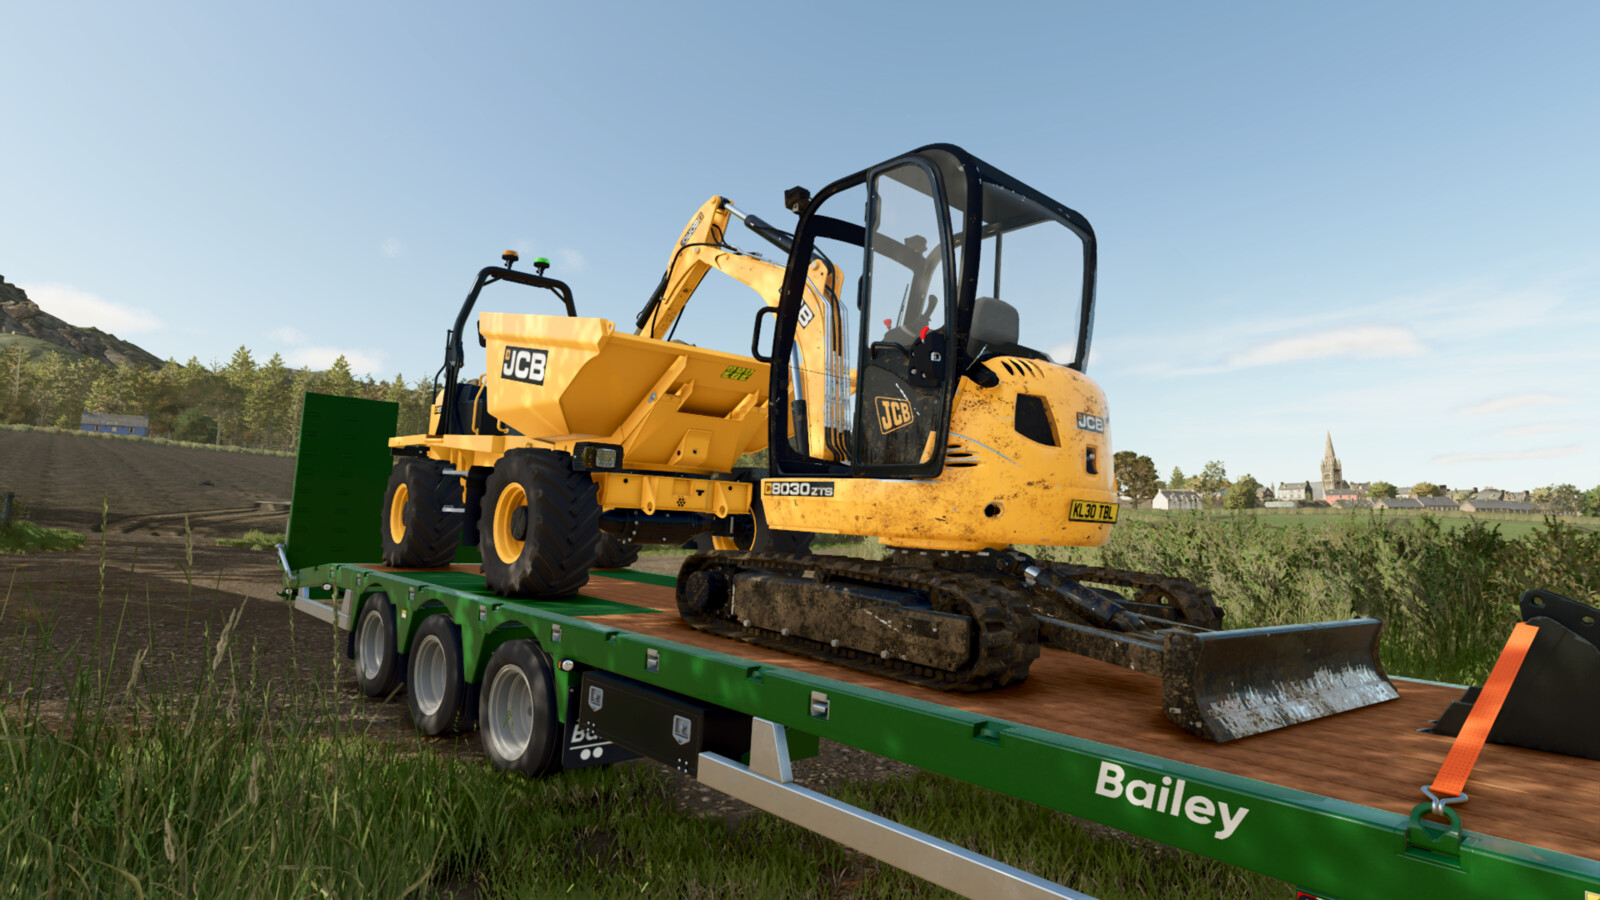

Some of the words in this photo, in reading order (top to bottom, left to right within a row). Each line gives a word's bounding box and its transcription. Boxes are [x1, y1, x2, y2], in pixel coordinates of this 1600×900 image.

[503, 350, 547, 382] JCB
[881, 400, 911, 430] JCB
[1078, 414, 1104, 431] JCB
[1073, 503, 1097, 519] KL30
[1099, 505, 1114, 520] TBL
[1095, 761, 1249, 840] Bailey
